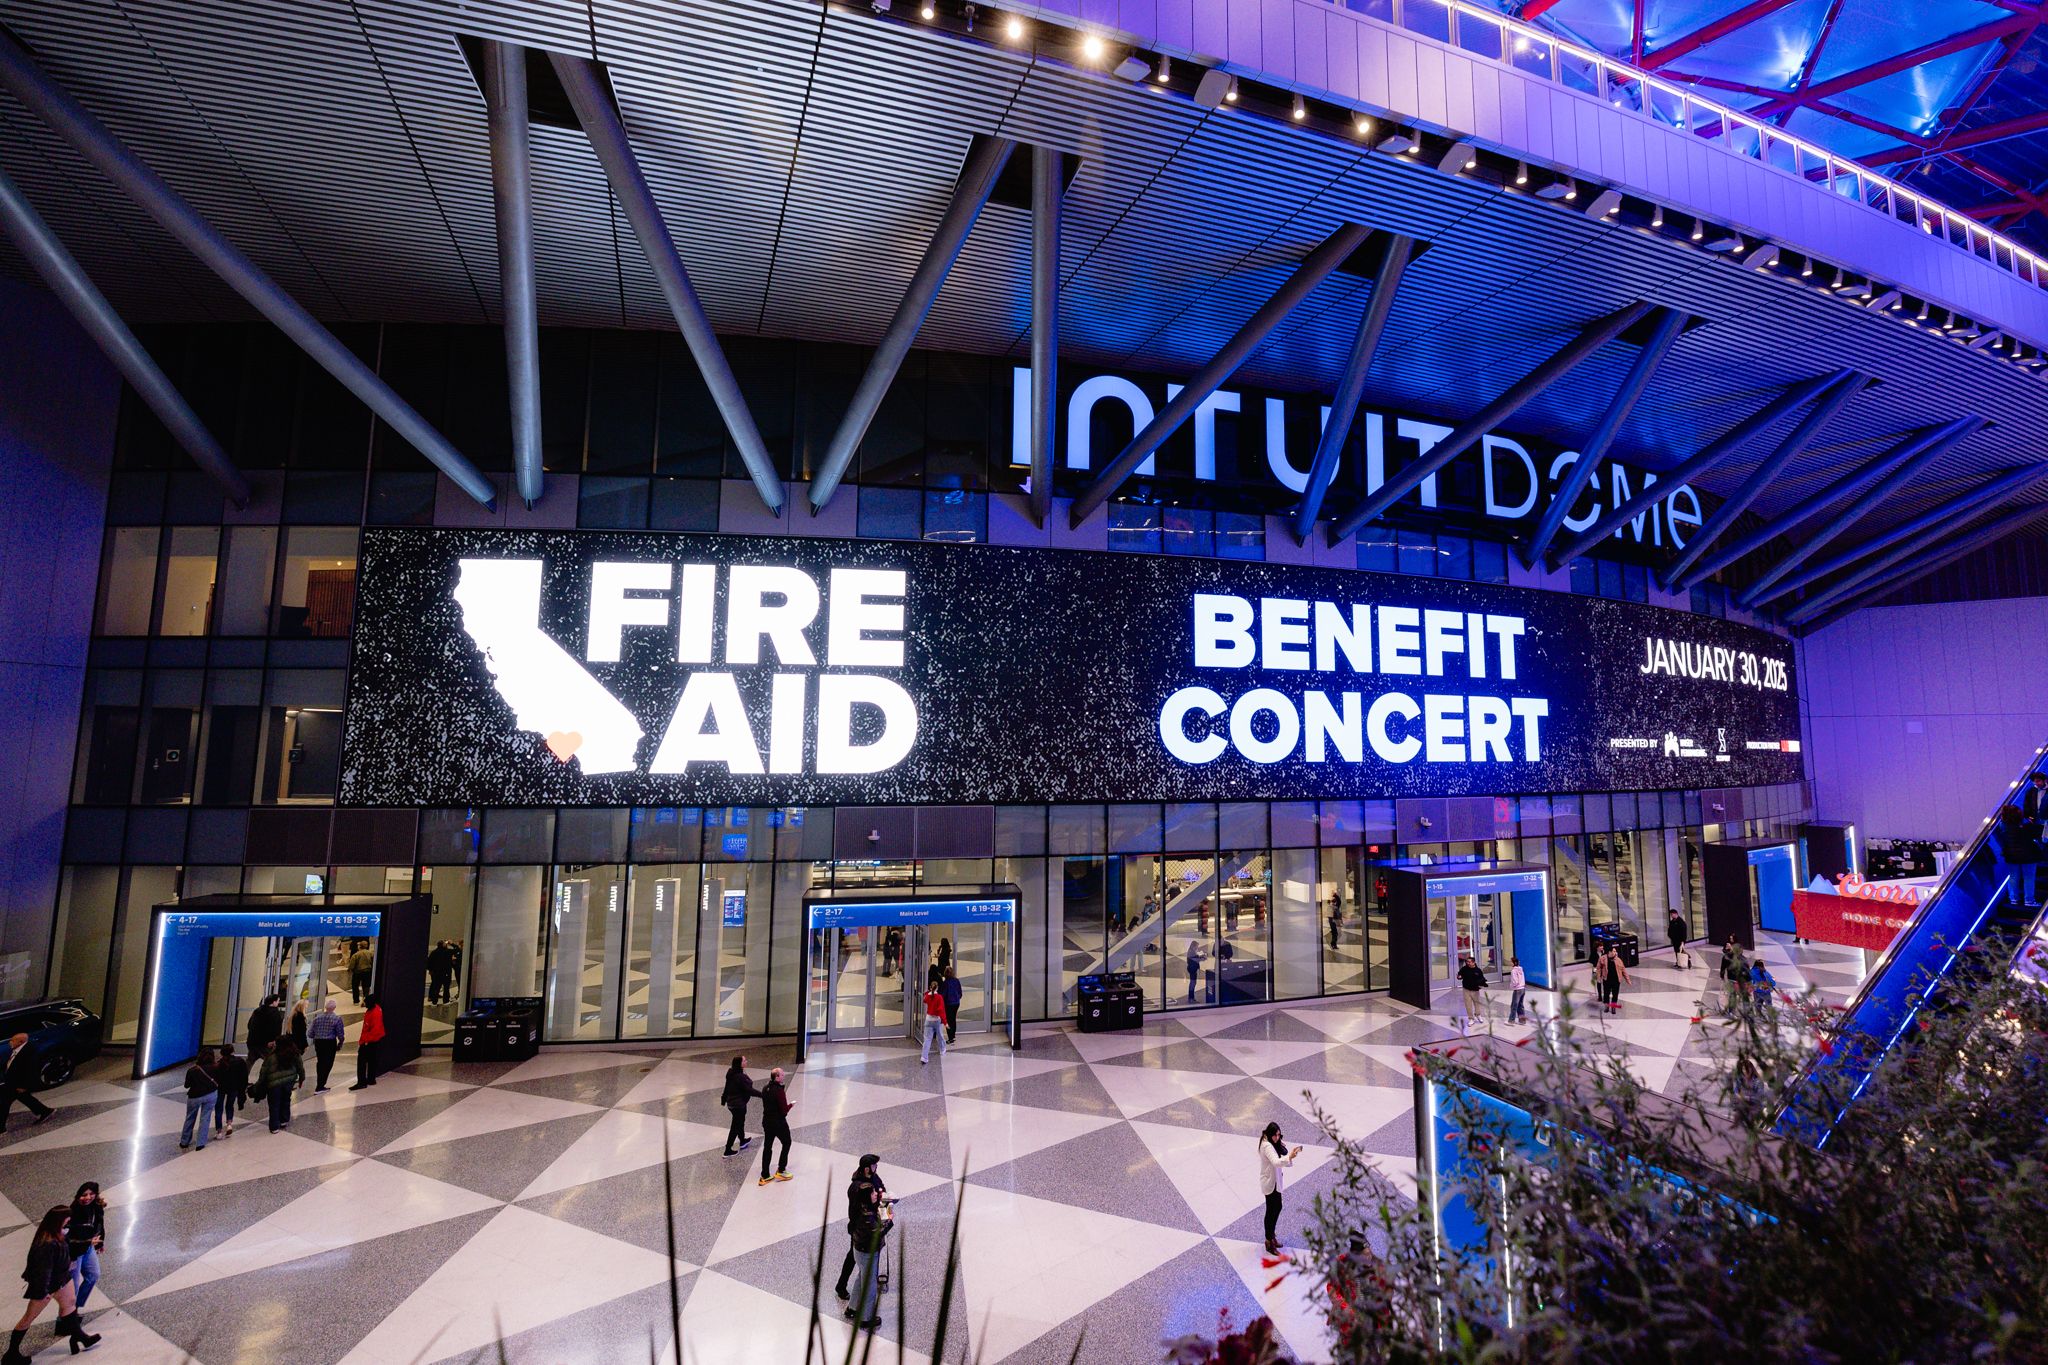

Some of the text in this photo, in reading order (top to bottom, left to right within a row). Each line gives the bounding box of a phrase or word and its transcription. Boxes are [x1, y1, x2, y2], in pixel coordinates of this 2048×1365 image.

[587, 562, 907, 667] FIRE
[1194, 593, 1525, 680] BENEFIT
[1641, 637, 1788, 691] JANUARY 30, 2025
[649, 672, 919, 775] AID
[1159, 686, 1549, 764] CONCERT
[1610, 738, 1658, 748] PRESENTED BY
[1836, 872, 1919, 905] Coors
[178, 916, 198, 924] 4-17
[320, 916, 368, 924] 1-2 & 19-32
[825, 908, 843, 916] 2-17
[979, 904, 1001, 912] 19-32
